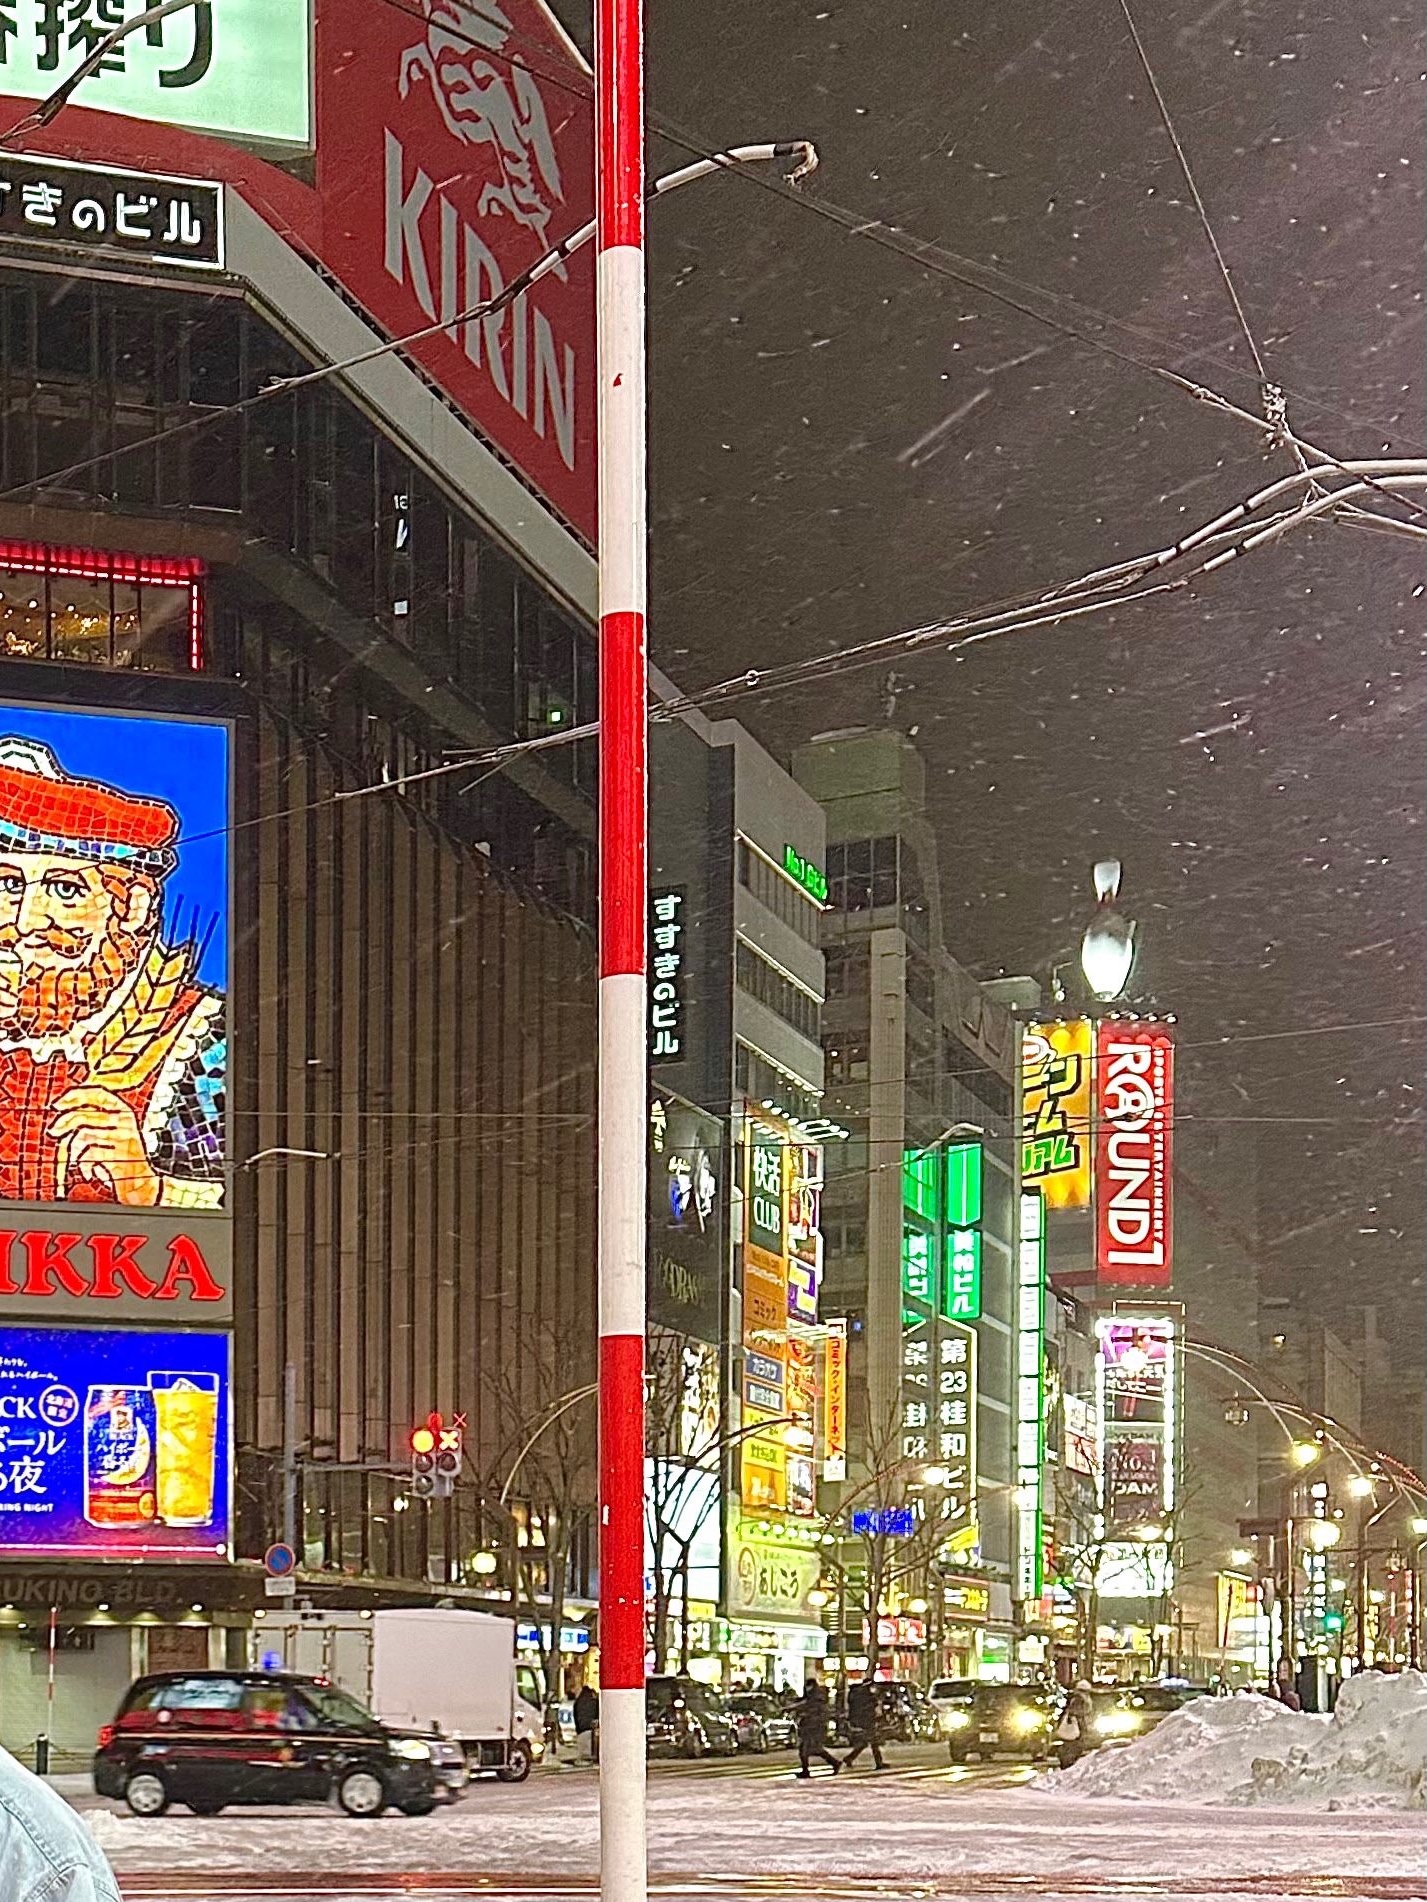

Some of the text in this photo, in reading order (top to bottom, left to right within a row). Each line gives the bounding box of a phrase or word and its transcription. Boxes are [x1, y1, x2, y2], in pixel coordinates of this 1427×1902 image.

[384, 126, 574, 472] KIRIN
[653, 894, 682, 1055] すすきのビル
[754, 1197, 781, 1233] CLUB
[24, 1503, 54, 1513] NIGHT
